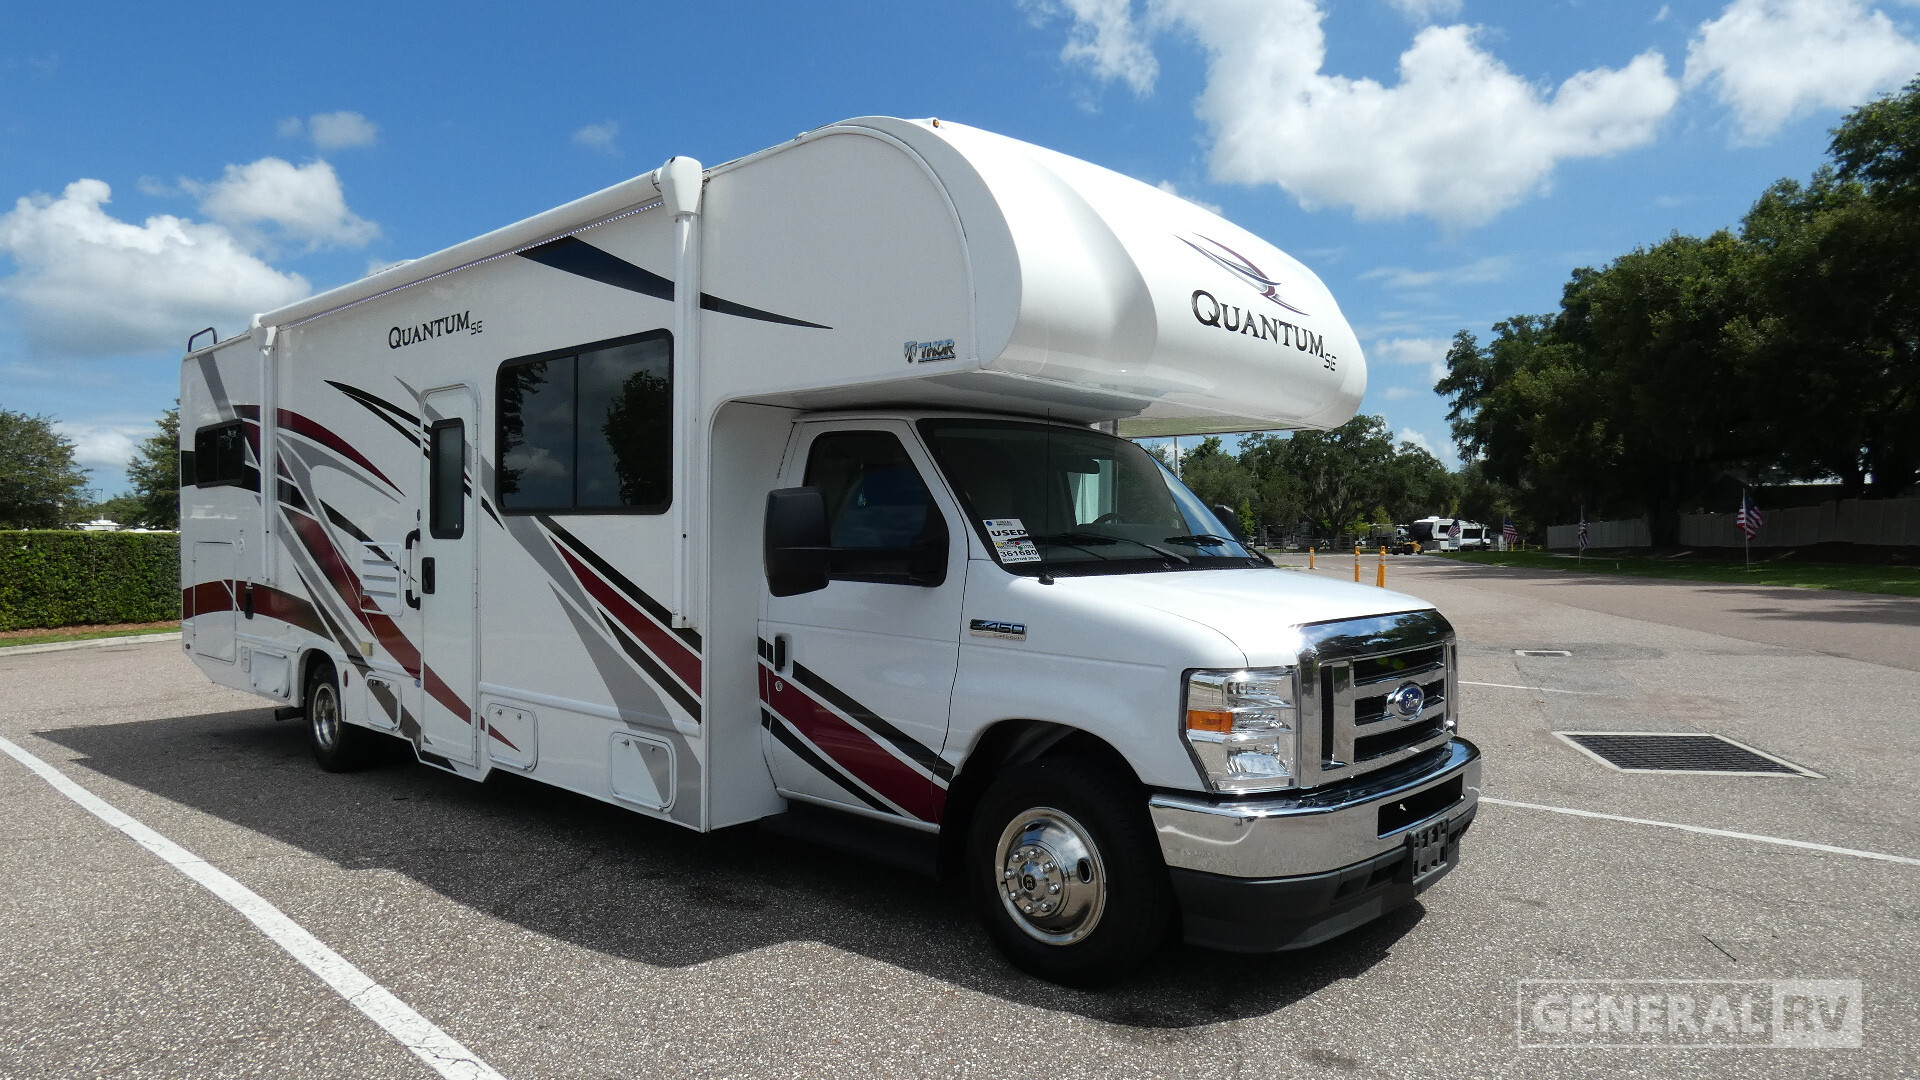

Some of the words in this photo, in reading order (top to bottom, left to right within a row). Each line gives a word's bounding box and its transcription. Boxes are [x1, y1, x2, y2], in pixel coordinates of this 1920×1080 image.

[388, 310, 470, 349] QUANTUM
[470, 320, 483, 335] SE
[1191, 289, 1325, 358] QUANTUM
[1324, 353, 1337, 371] SE
[918, 339, 955, 359] THOR
[991, 529, 1027, 537] USED
[1000, 549, 1038, 558] 361680
